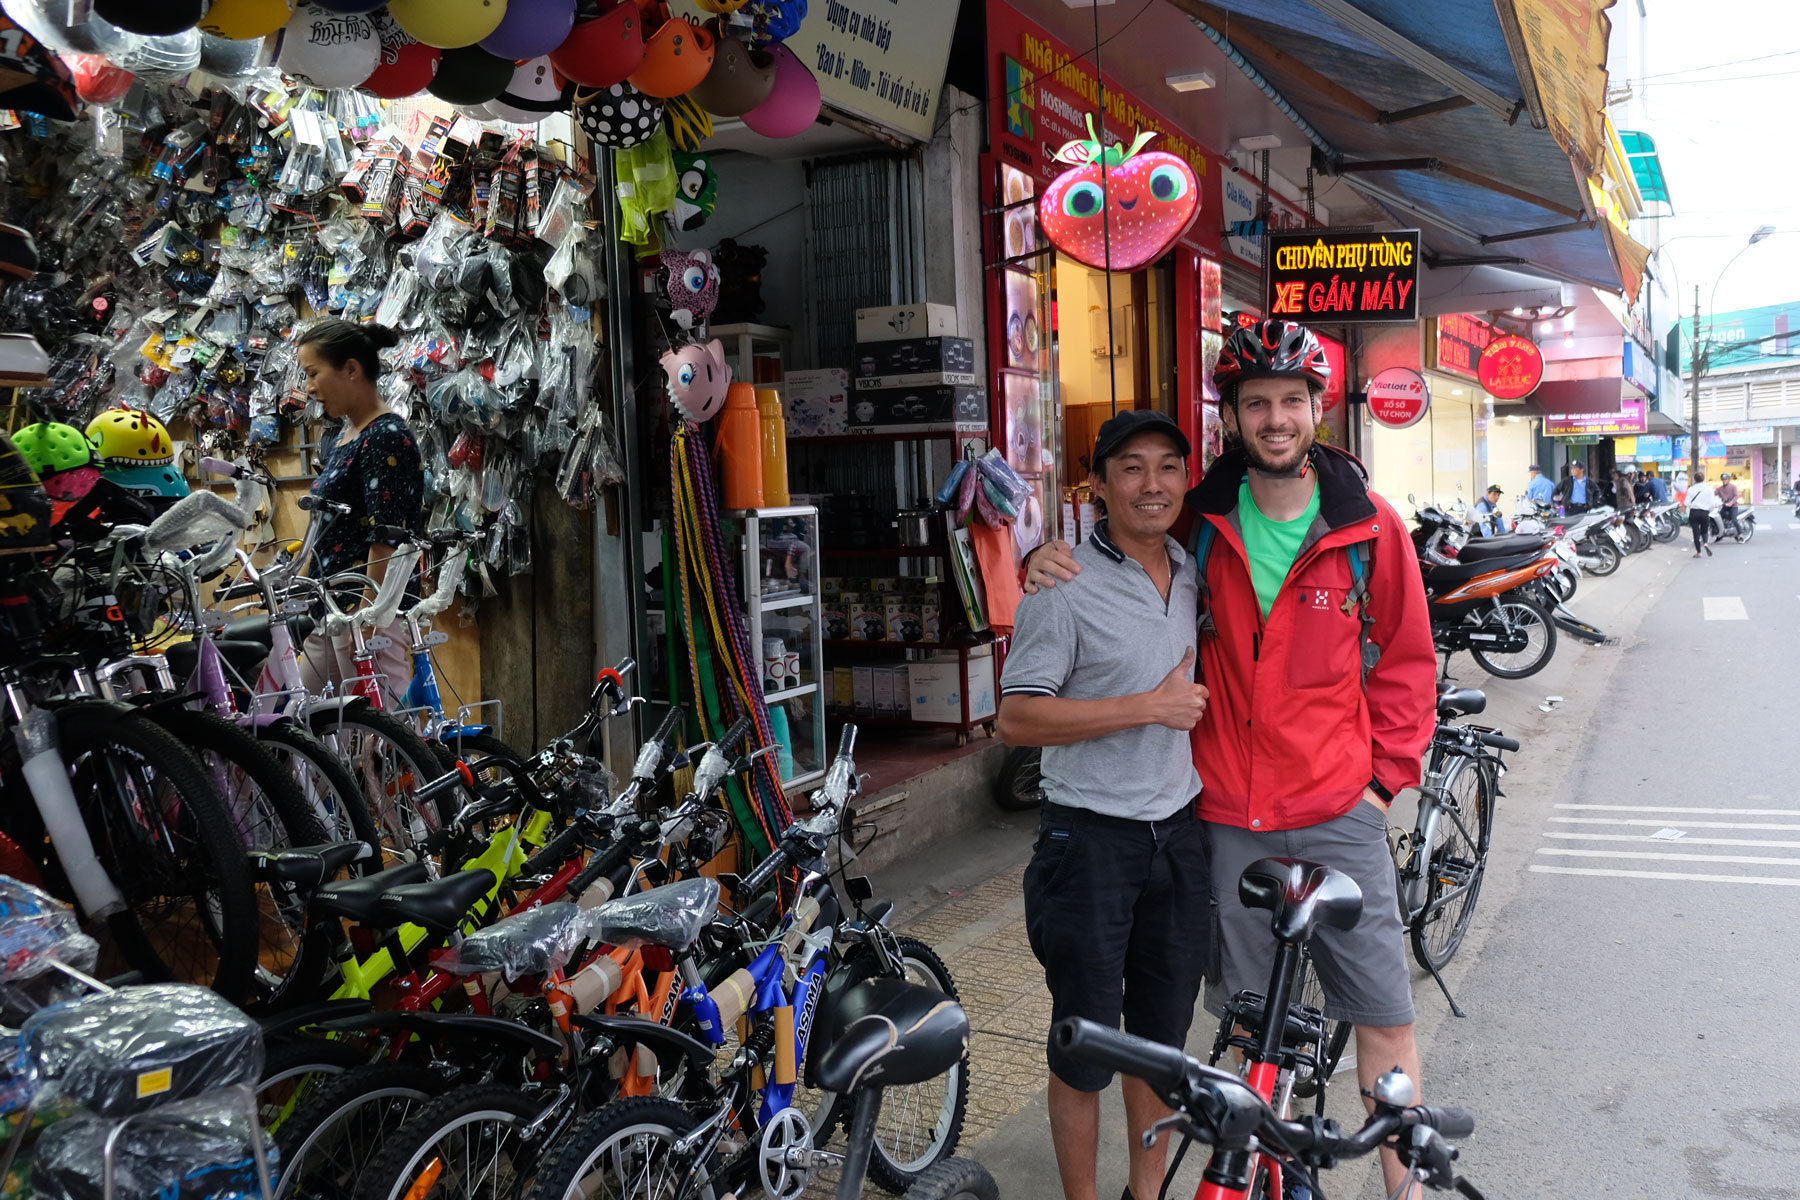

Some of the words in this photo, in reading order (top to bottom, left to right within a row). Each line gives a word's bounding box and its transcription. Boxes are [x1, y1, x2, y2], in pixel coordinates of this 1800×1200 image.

[848, 12, 860, 42] cụ
[860, 15, 878, 43] nhà
[876, 20, 892, 54] bếp
[850, 58, 872, 92] Nilon
[876, 70, 891, 101] Túi
[890, 74, 904, 109] xốp
[912, 88, 922, 112] và
[1024, 32, 1052, 74] NHÀ
[1056, 53, 1088, 99] HÀNG
[1112, 92, 1126, 122] VÀ
[1276, 238, 1335, 270] CHUYÊN
[1336, 243, 1368, 272] PHỤ
[1369, 235, 1412, 267] TÙNG
[1272, 281, 1306, 314] XE
[1360, 272, 1414, 310] MÁY
[858, 378, 882, 388] VISIONS
[1375, 382, 1407, 390] Vietlott
[1379, 410, 1389, 418] TỰ
[1390, 410, 1412, 420] CHỌN
[796, 972, 822, 1048] ASAMA
